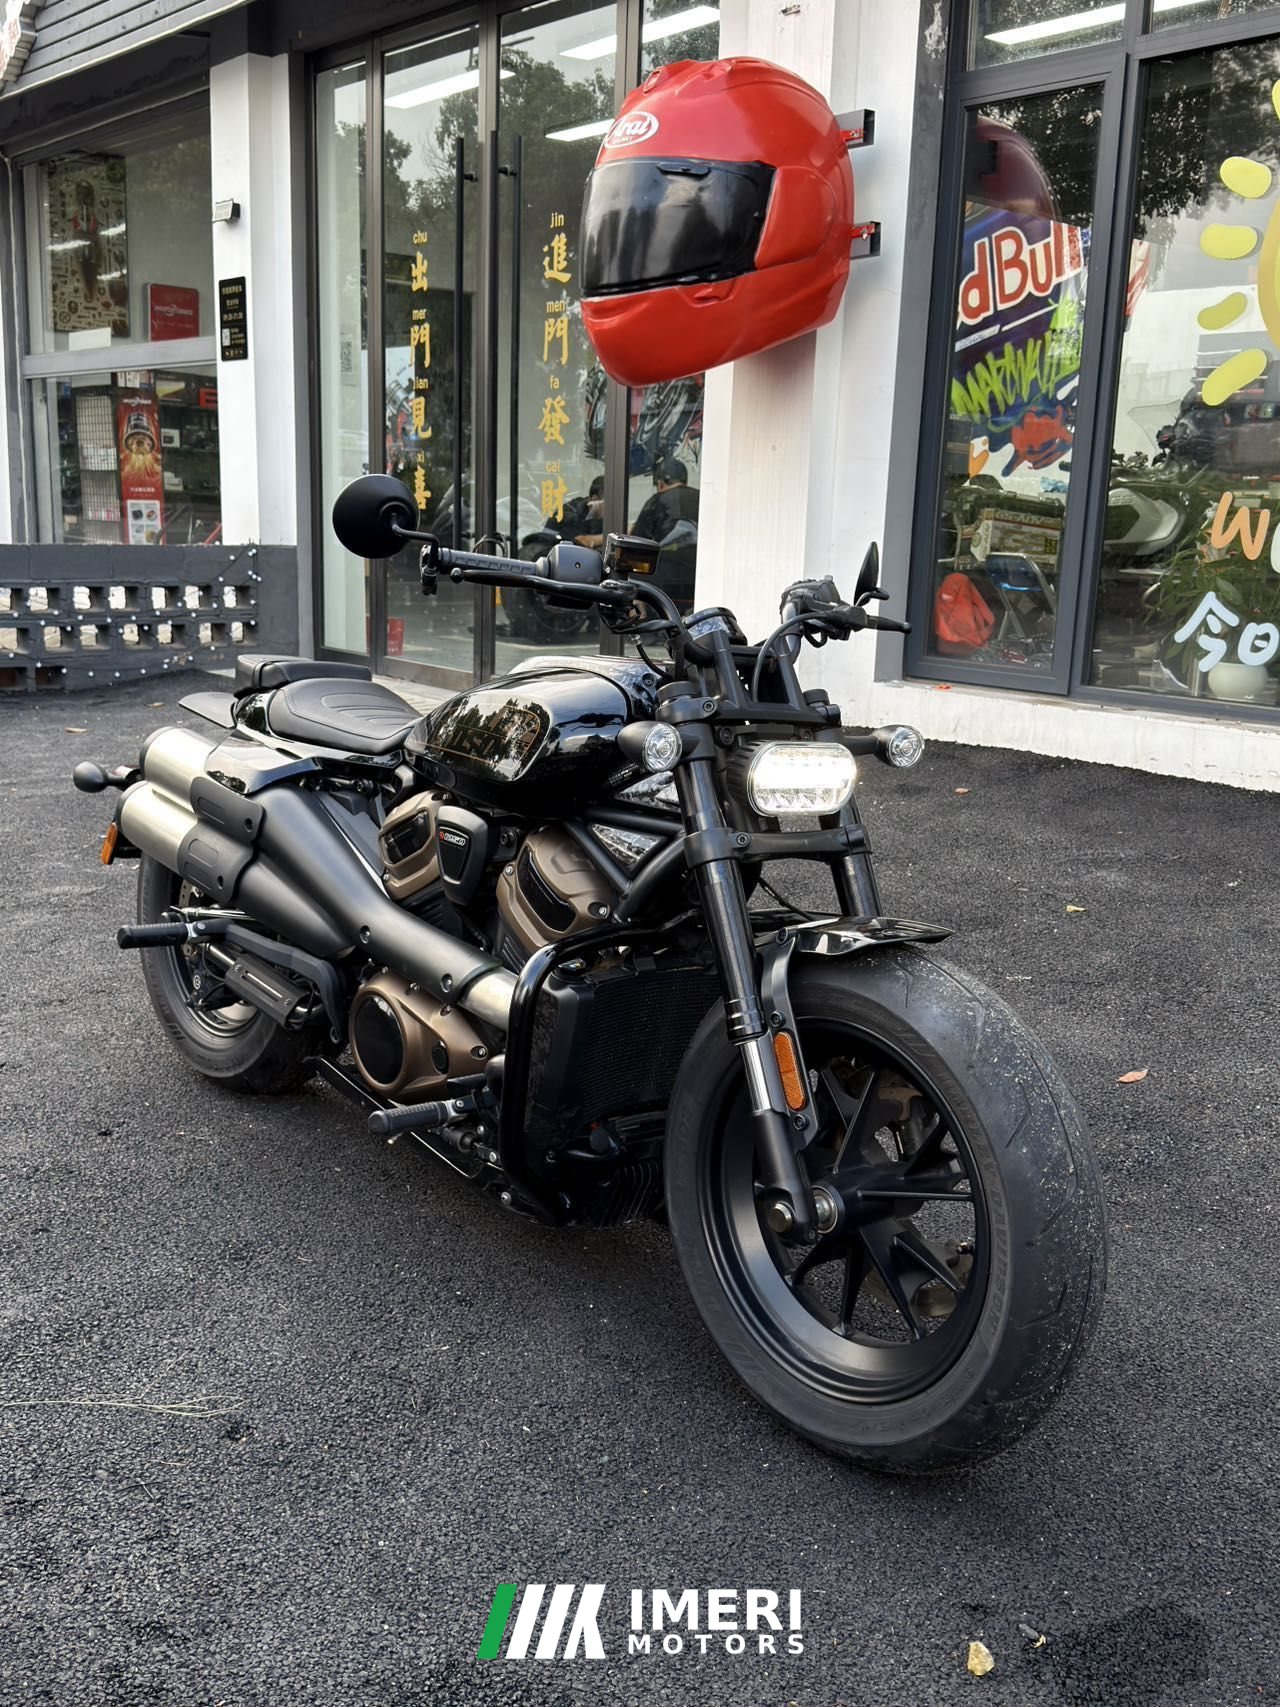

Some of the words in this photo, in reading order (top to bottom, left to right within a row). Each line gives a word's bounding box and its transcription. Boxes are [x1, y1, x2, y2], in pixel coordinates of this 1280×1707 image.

[550, 212, 564, 228] jin
[413, 230, 428, 244] chu
[546, 300, 565, 313] men
[550, 375, 560, 389] fa
